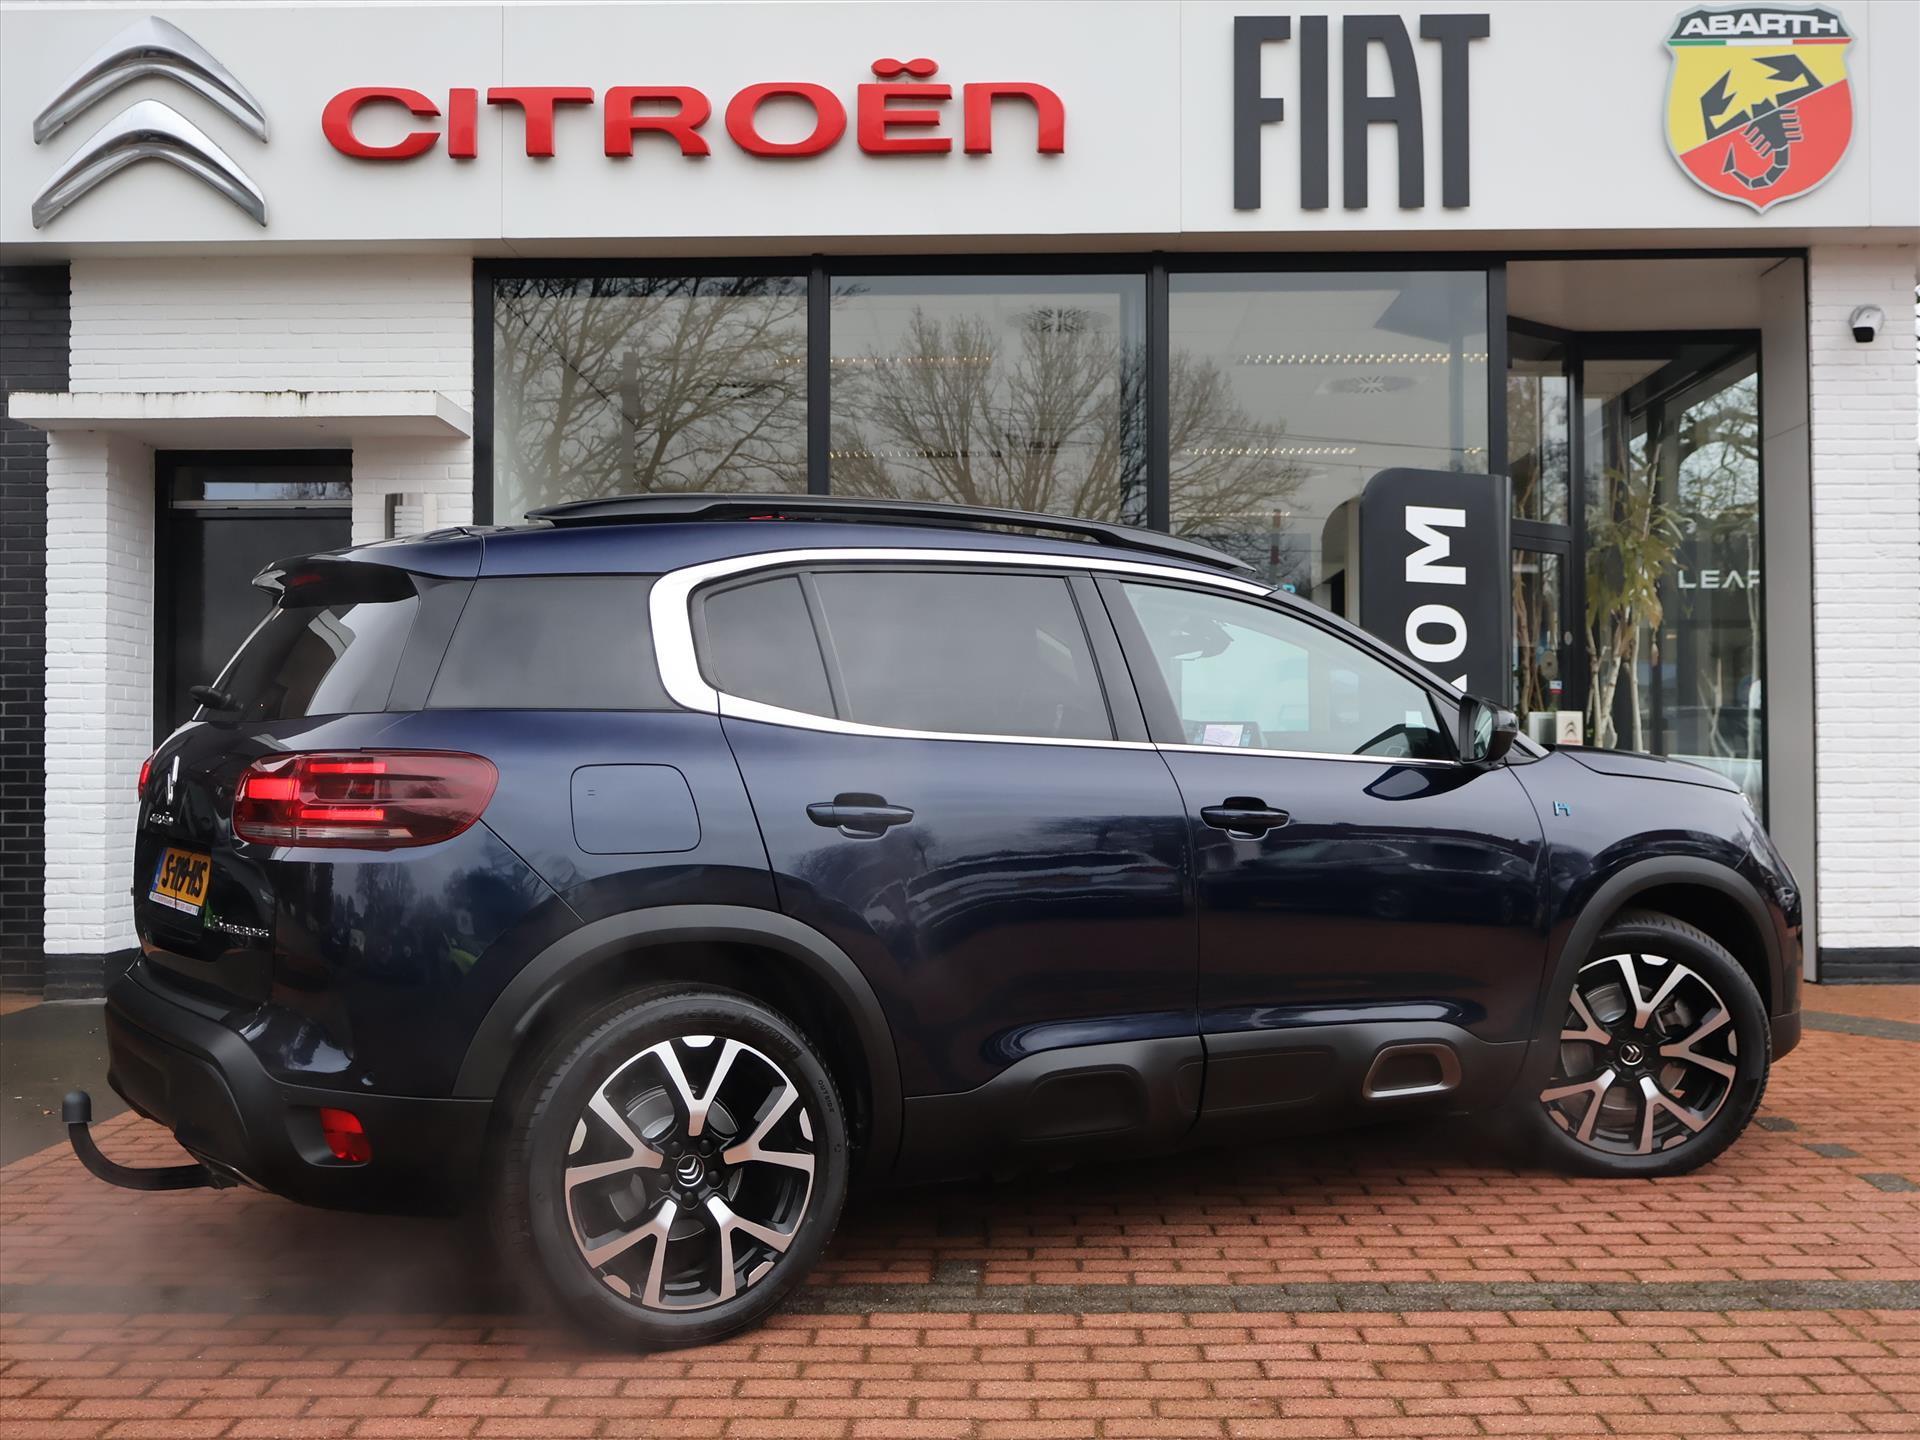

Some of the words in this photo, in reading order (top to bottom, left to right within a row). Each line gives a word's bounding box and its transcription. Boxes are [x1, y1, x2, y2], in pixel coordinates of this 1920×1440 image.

[1233, 14, 1490, 209] FIAT
[1680, 13, 1838, 36] ABARTH
[1405, 505, 1468, 693] OM
